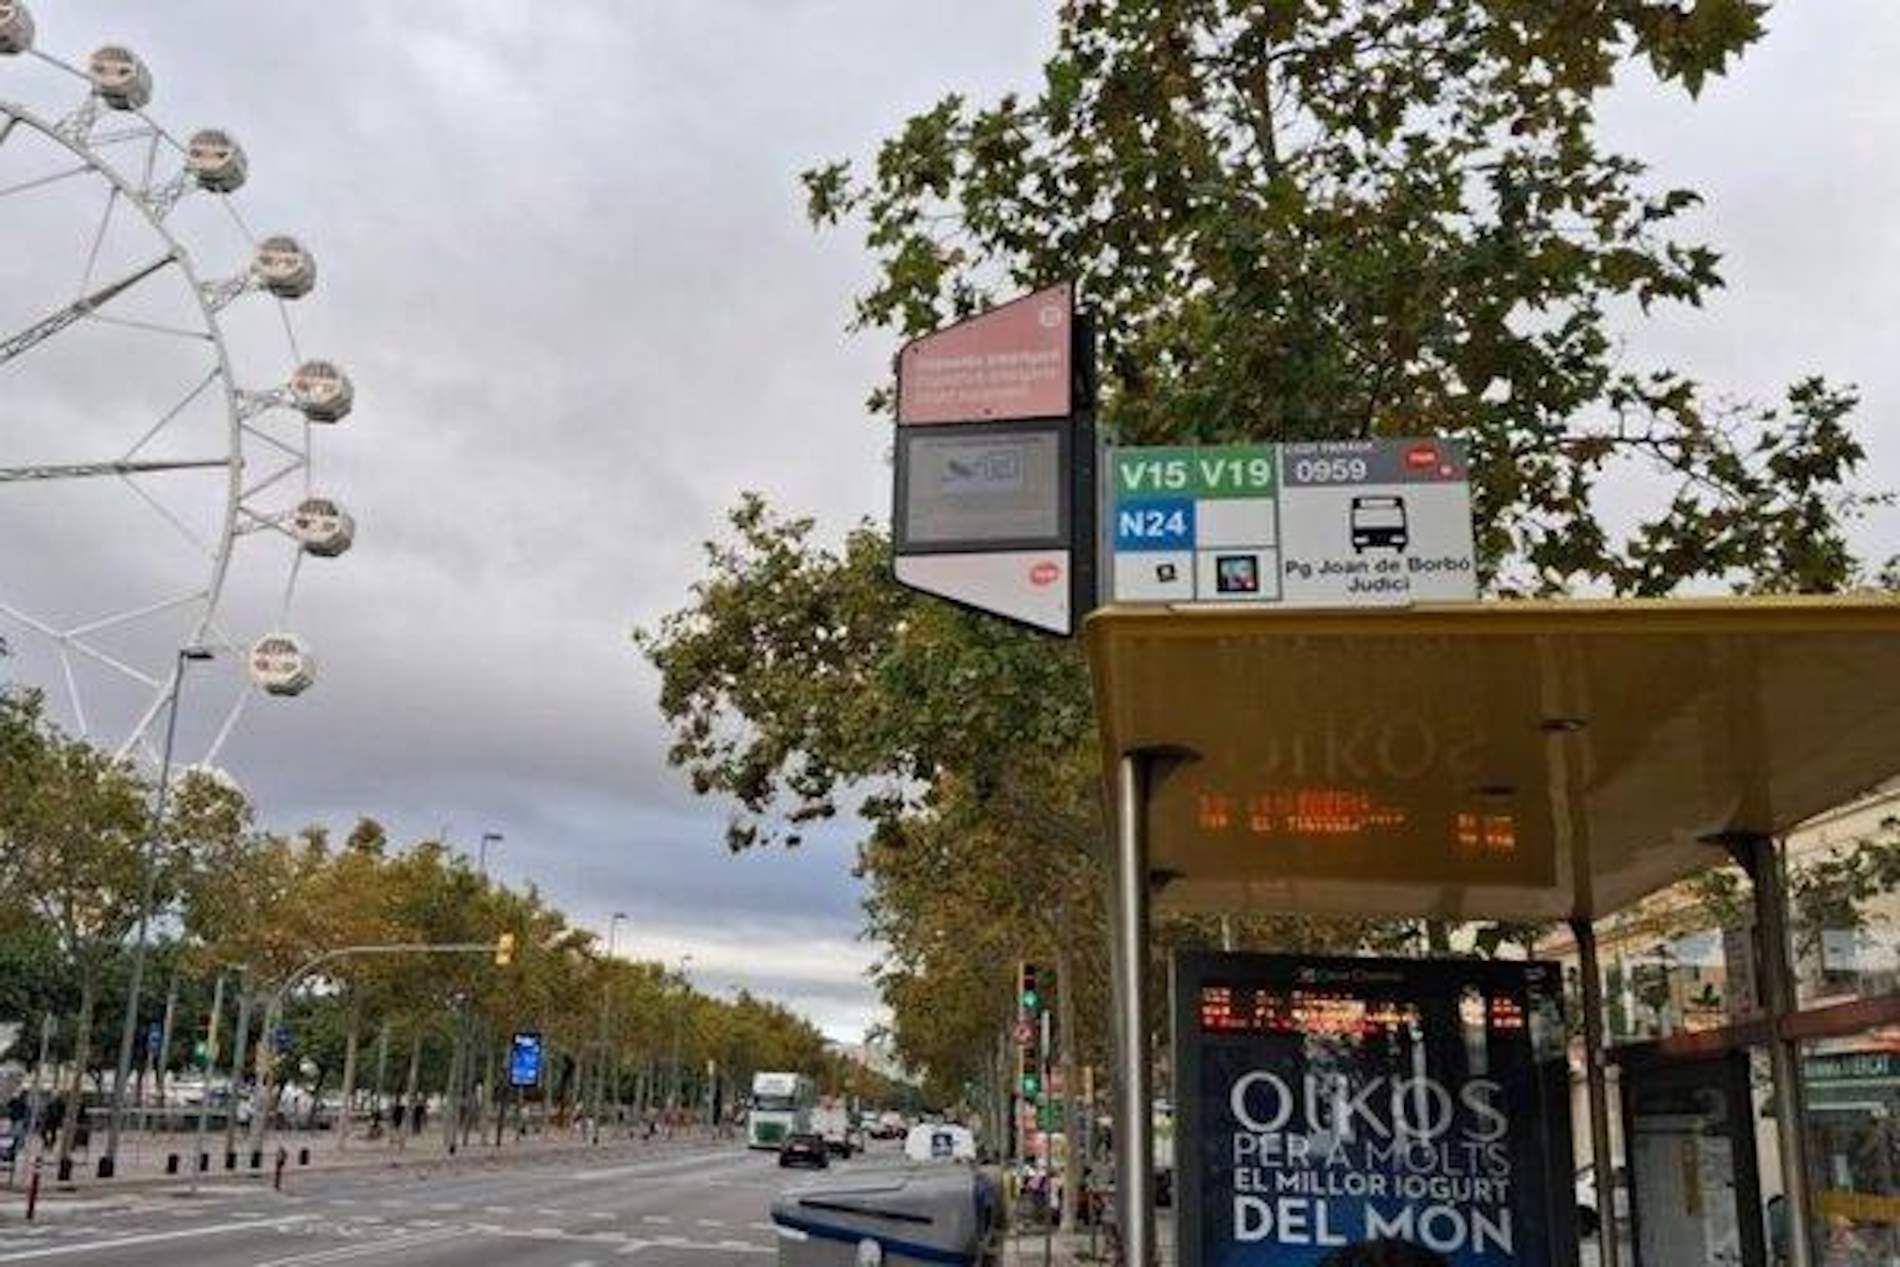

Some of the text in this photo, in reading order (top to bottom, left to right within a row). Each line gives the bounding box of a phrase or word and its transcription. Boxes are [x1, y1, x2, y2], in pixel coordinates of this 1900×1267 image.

[1120, 458, 1272, 490] V15 V19
[1296, 458, 1368, 483] 0959
[1119, 510, 1187, 538] N24
[1285, 560, 1314, 578] Pg
[1318, 559, 1369, 576] Joan
[1375, 558, 1401, 574] de
[1349, 575, 1411, 594] Judici
[1229, 1069, 1510, 1143] OIKOS
[1233, 1131, 1310, 1168] PER
[1366, 1138, 1512, 1177] MOLTS
[1233, 1167, 1511, 1204] EL MILLOR IOGURT
[1233, 1195, 1348, 1247] DEL
